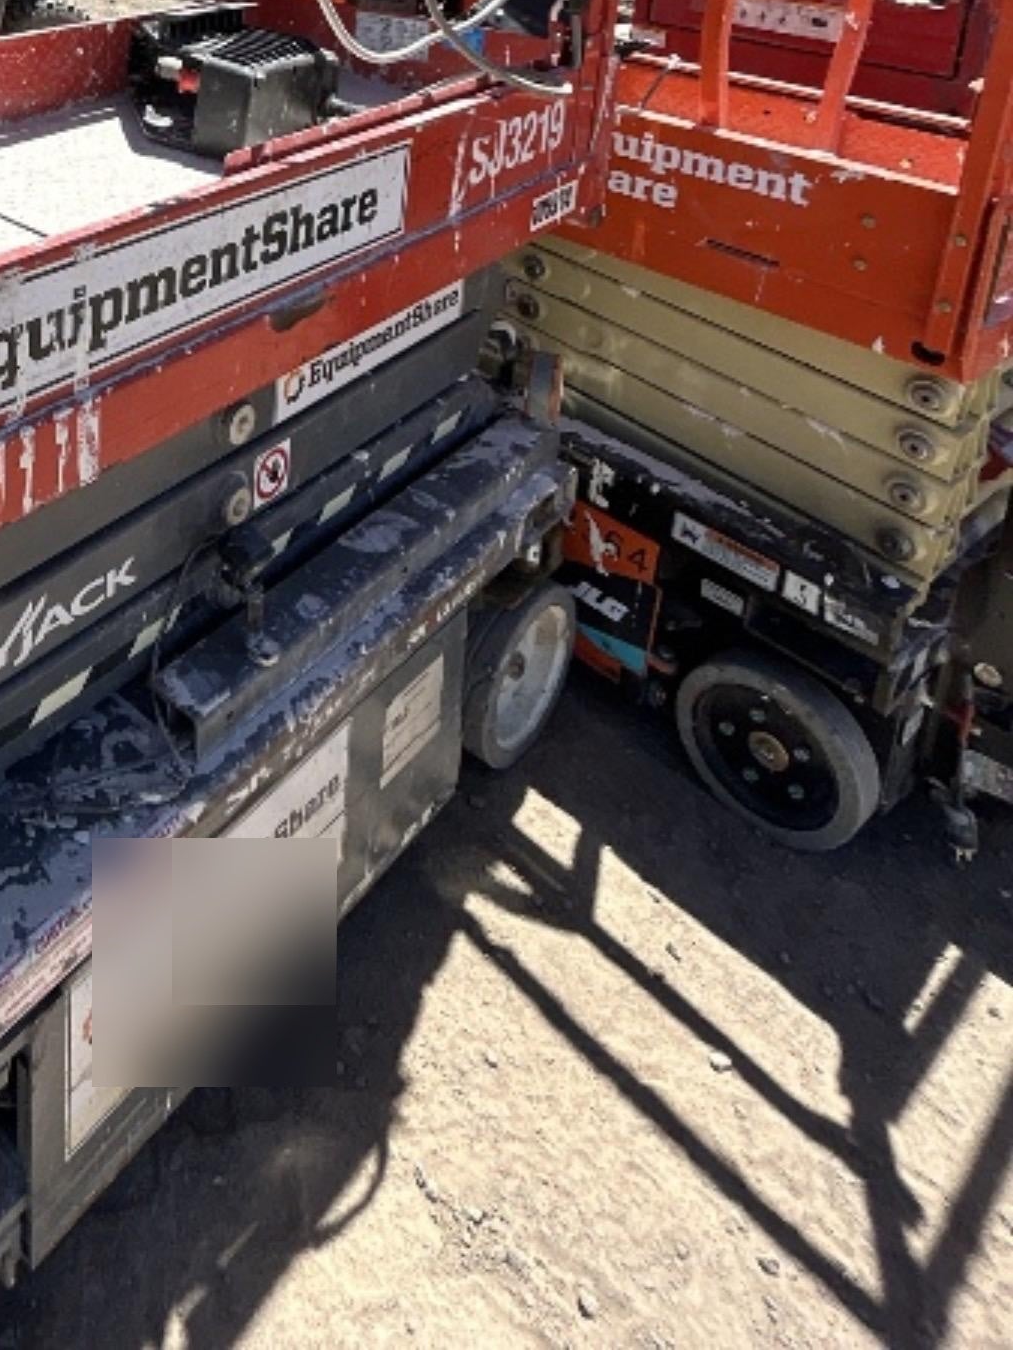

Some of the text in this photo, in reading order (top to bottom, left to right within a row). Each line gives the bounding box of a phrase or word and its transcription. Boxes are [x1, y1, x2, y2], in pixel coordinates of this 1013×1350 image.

[468, 100, 565, 185] SJ3219
[611, 131, 813, 207] uipment
[307, 290, 459, 388] EquipmentShare
